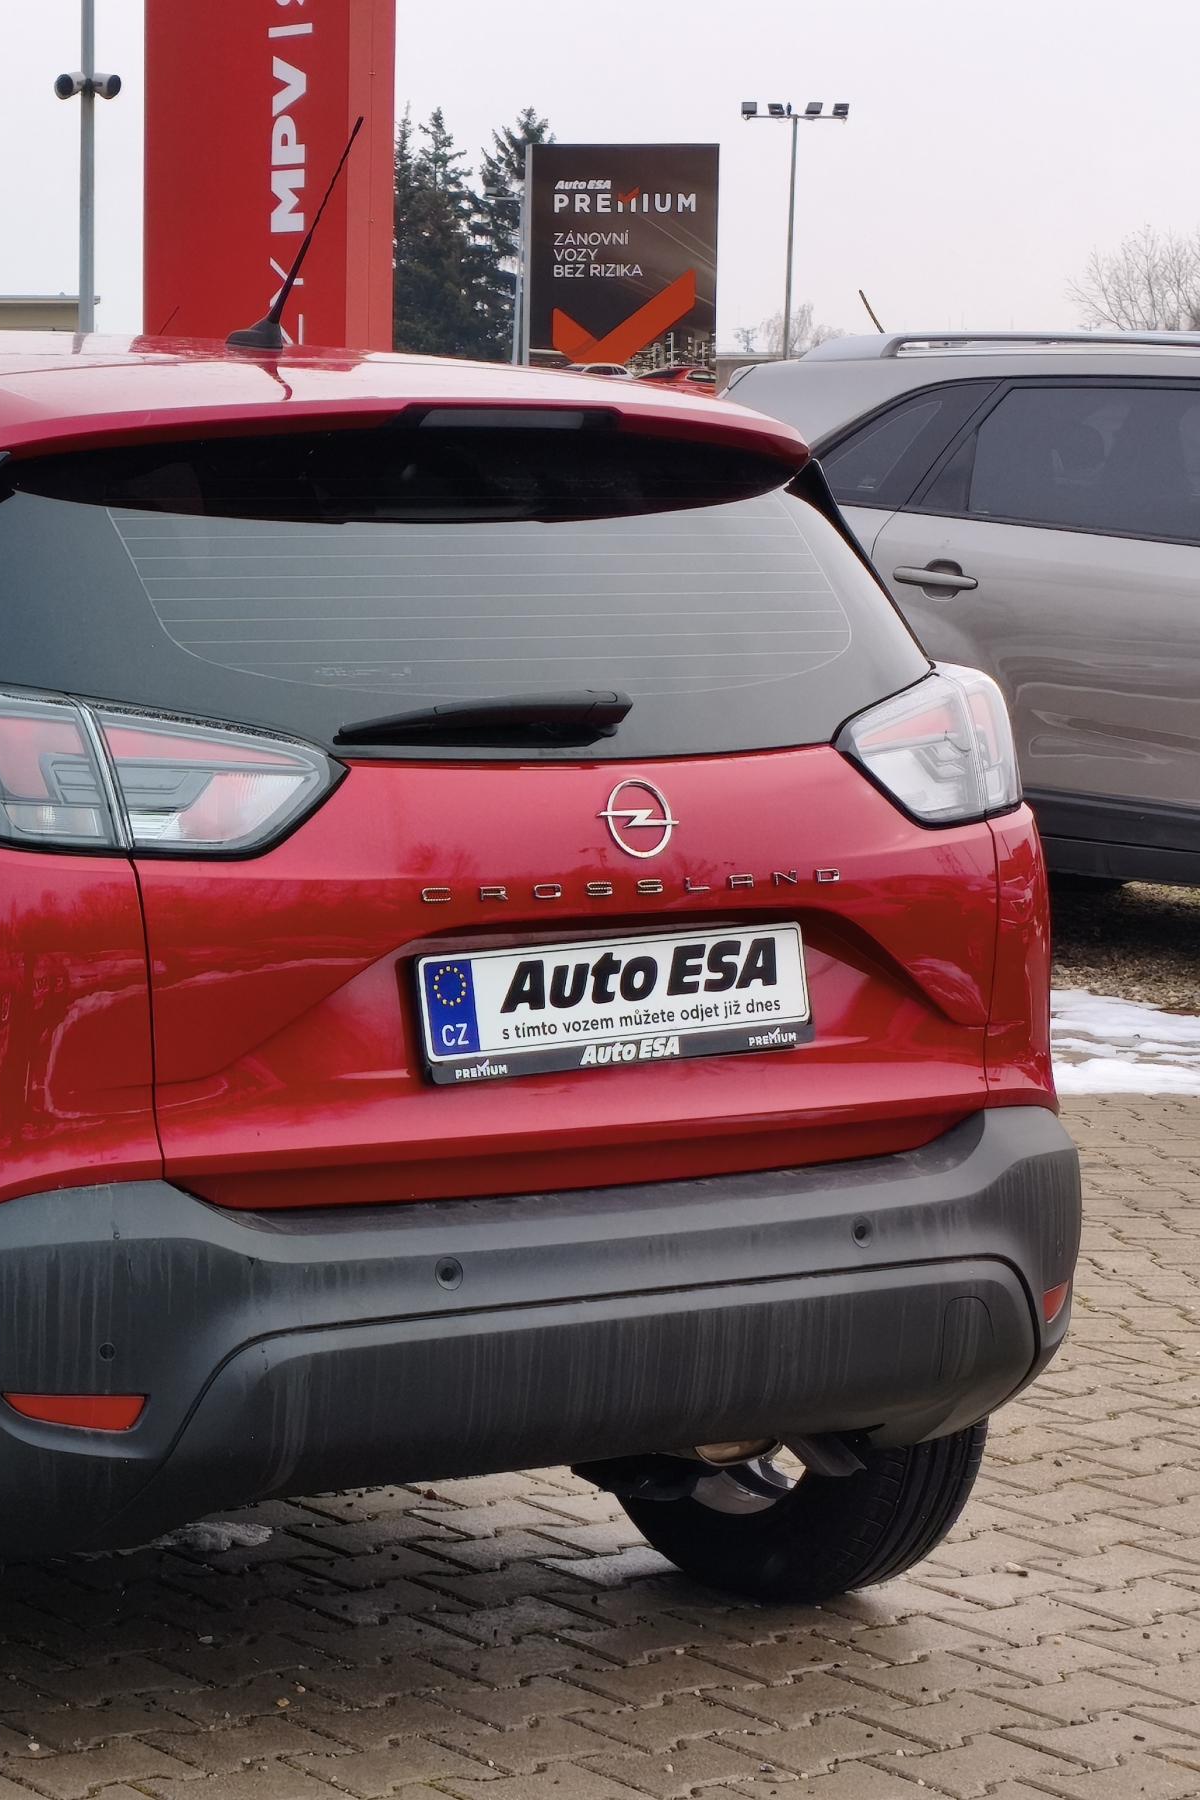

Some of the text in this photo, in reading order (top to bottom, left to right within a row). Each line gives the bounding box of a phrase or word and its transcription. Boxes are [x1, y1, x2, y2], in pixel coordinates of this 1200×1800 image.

[271, 56, 307, 232] MPV
[555, 180, 611, 190] Auto ESA
[553, 189, 697, 213] PREMIUM
[553, 230, 629, 246] ZÁNOVNÍ
[553, 249, 598, 262] VOZY
[553, 264, 643, 278] BEZ RIZIKA
[421, 868, 841, 902] CROSSLAND
[500, 937, 777, 1013] Auto ESA
[502, 999, 781, 1040] s tímto vozem můžete odjet již dnes
[441, 1023, 469, 1046] CZ
[748, 1029, 797, 1047] PREMIUM
[579, 1036, 680, 1066] Auto ESA
[455, 1062, 508, 1079] PREMIUM
